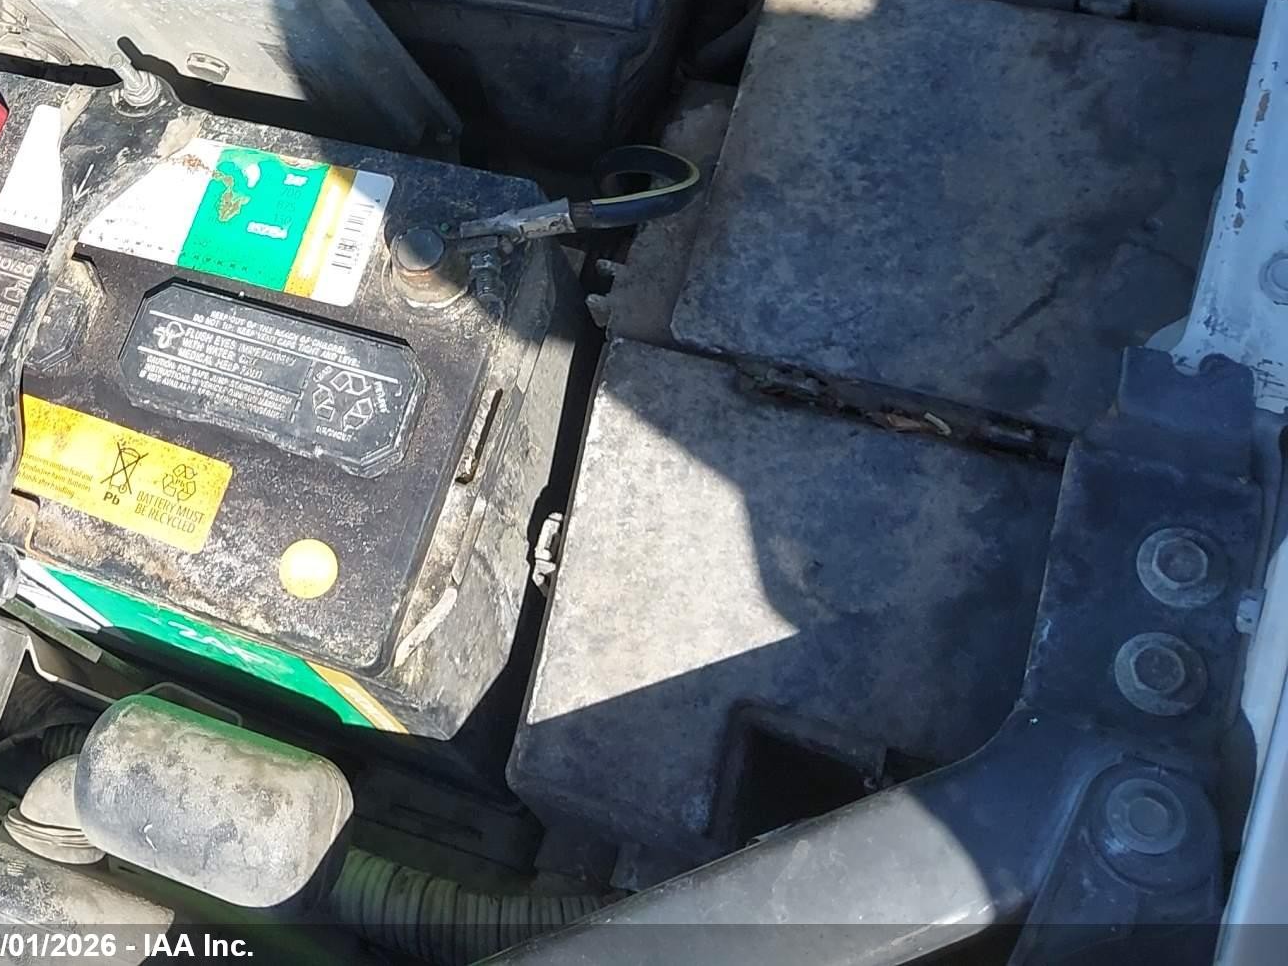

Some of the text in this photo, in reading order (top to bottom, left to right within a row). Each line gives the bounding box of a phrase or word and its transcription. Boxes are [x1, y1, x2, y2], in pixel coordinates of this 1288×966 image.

[204, 316, 221, 328] NOT
[180, 337, 208, 352] WITH
[184, 327, 215, 344] FLUSH
[212, 336, 238, 351] EYES
[176, 346, 216, 365] MEDICAL
[103, 491, 121, 506] Pb
[136, 490, 206, 524] BATTERY MUST
[134, 504, 197, 534] BE RECYCLED
